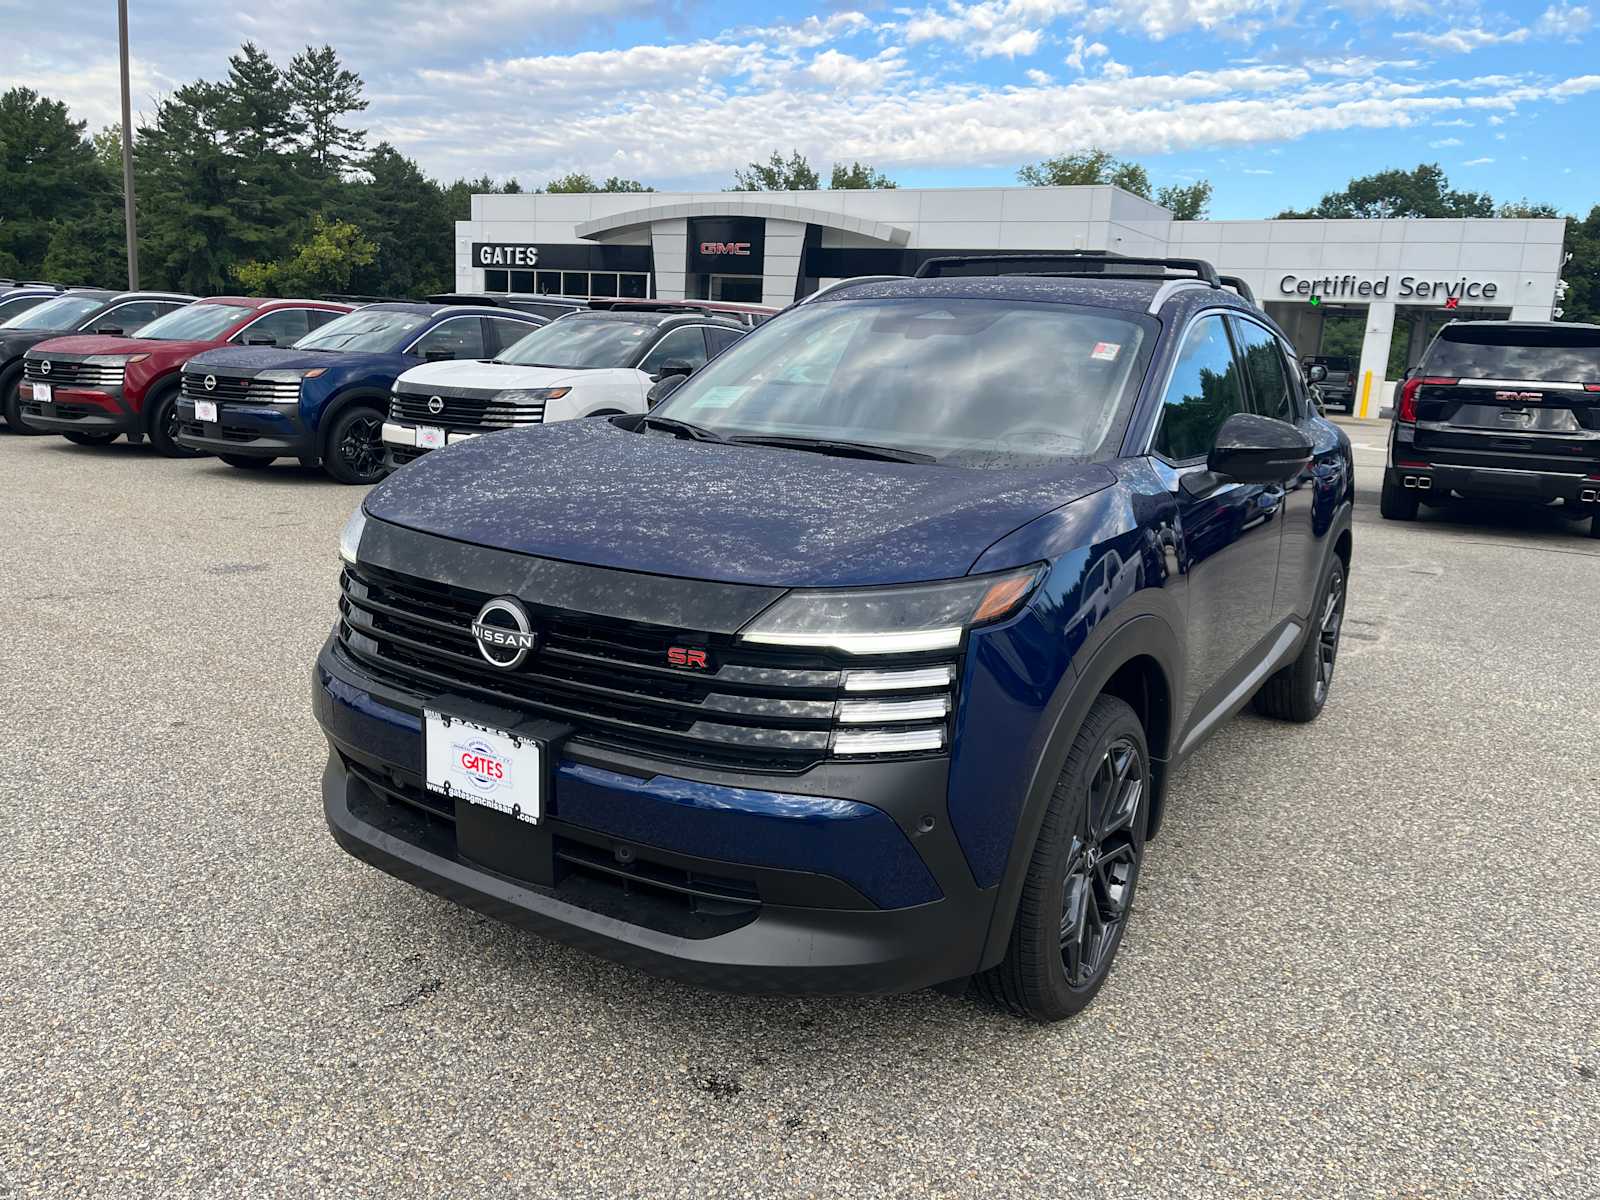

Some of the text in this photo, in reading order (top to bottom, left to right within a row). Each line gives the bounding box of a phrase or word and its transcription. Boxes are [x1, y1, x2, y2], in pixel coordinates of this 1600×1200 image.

[480, 246, 539, 266] GATES
[700, 242, 751, 256] GMC
[1279, 274, 1498, 299] Certified Service
[471, 625, 532, 648] NISSAN
[667, 646, 707, 669] SR
[461, 752, 504, 780] GATES
